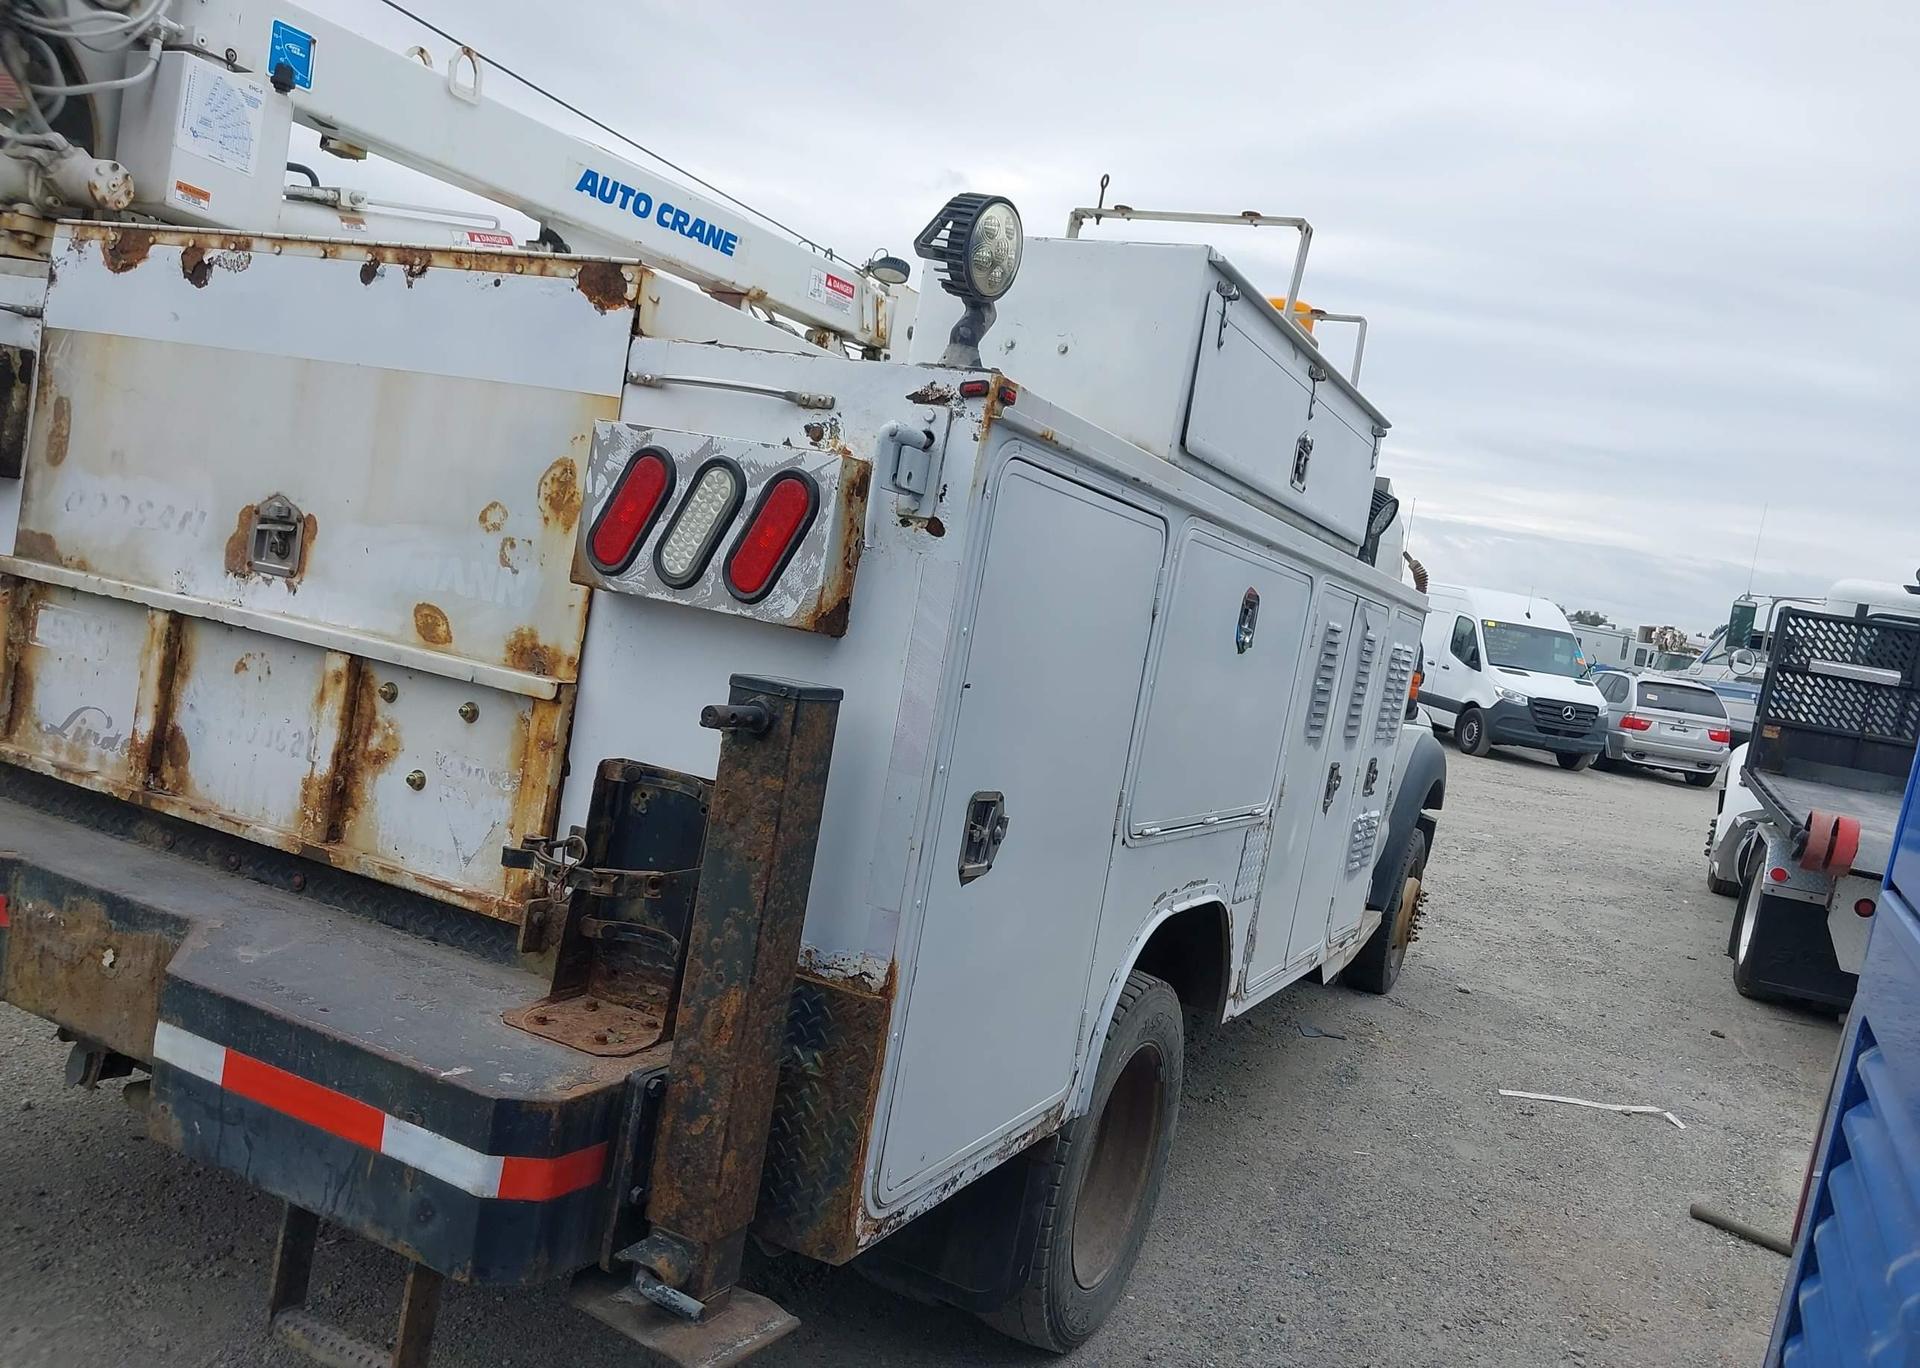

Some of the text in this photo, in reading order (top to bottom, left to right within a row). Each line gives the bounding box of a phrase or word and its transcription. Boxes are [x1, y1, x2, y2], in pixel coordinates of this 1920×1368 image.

[575, 168, 738, 257] AUTO CRANE
[480, 234, 510, 244] DANGER
